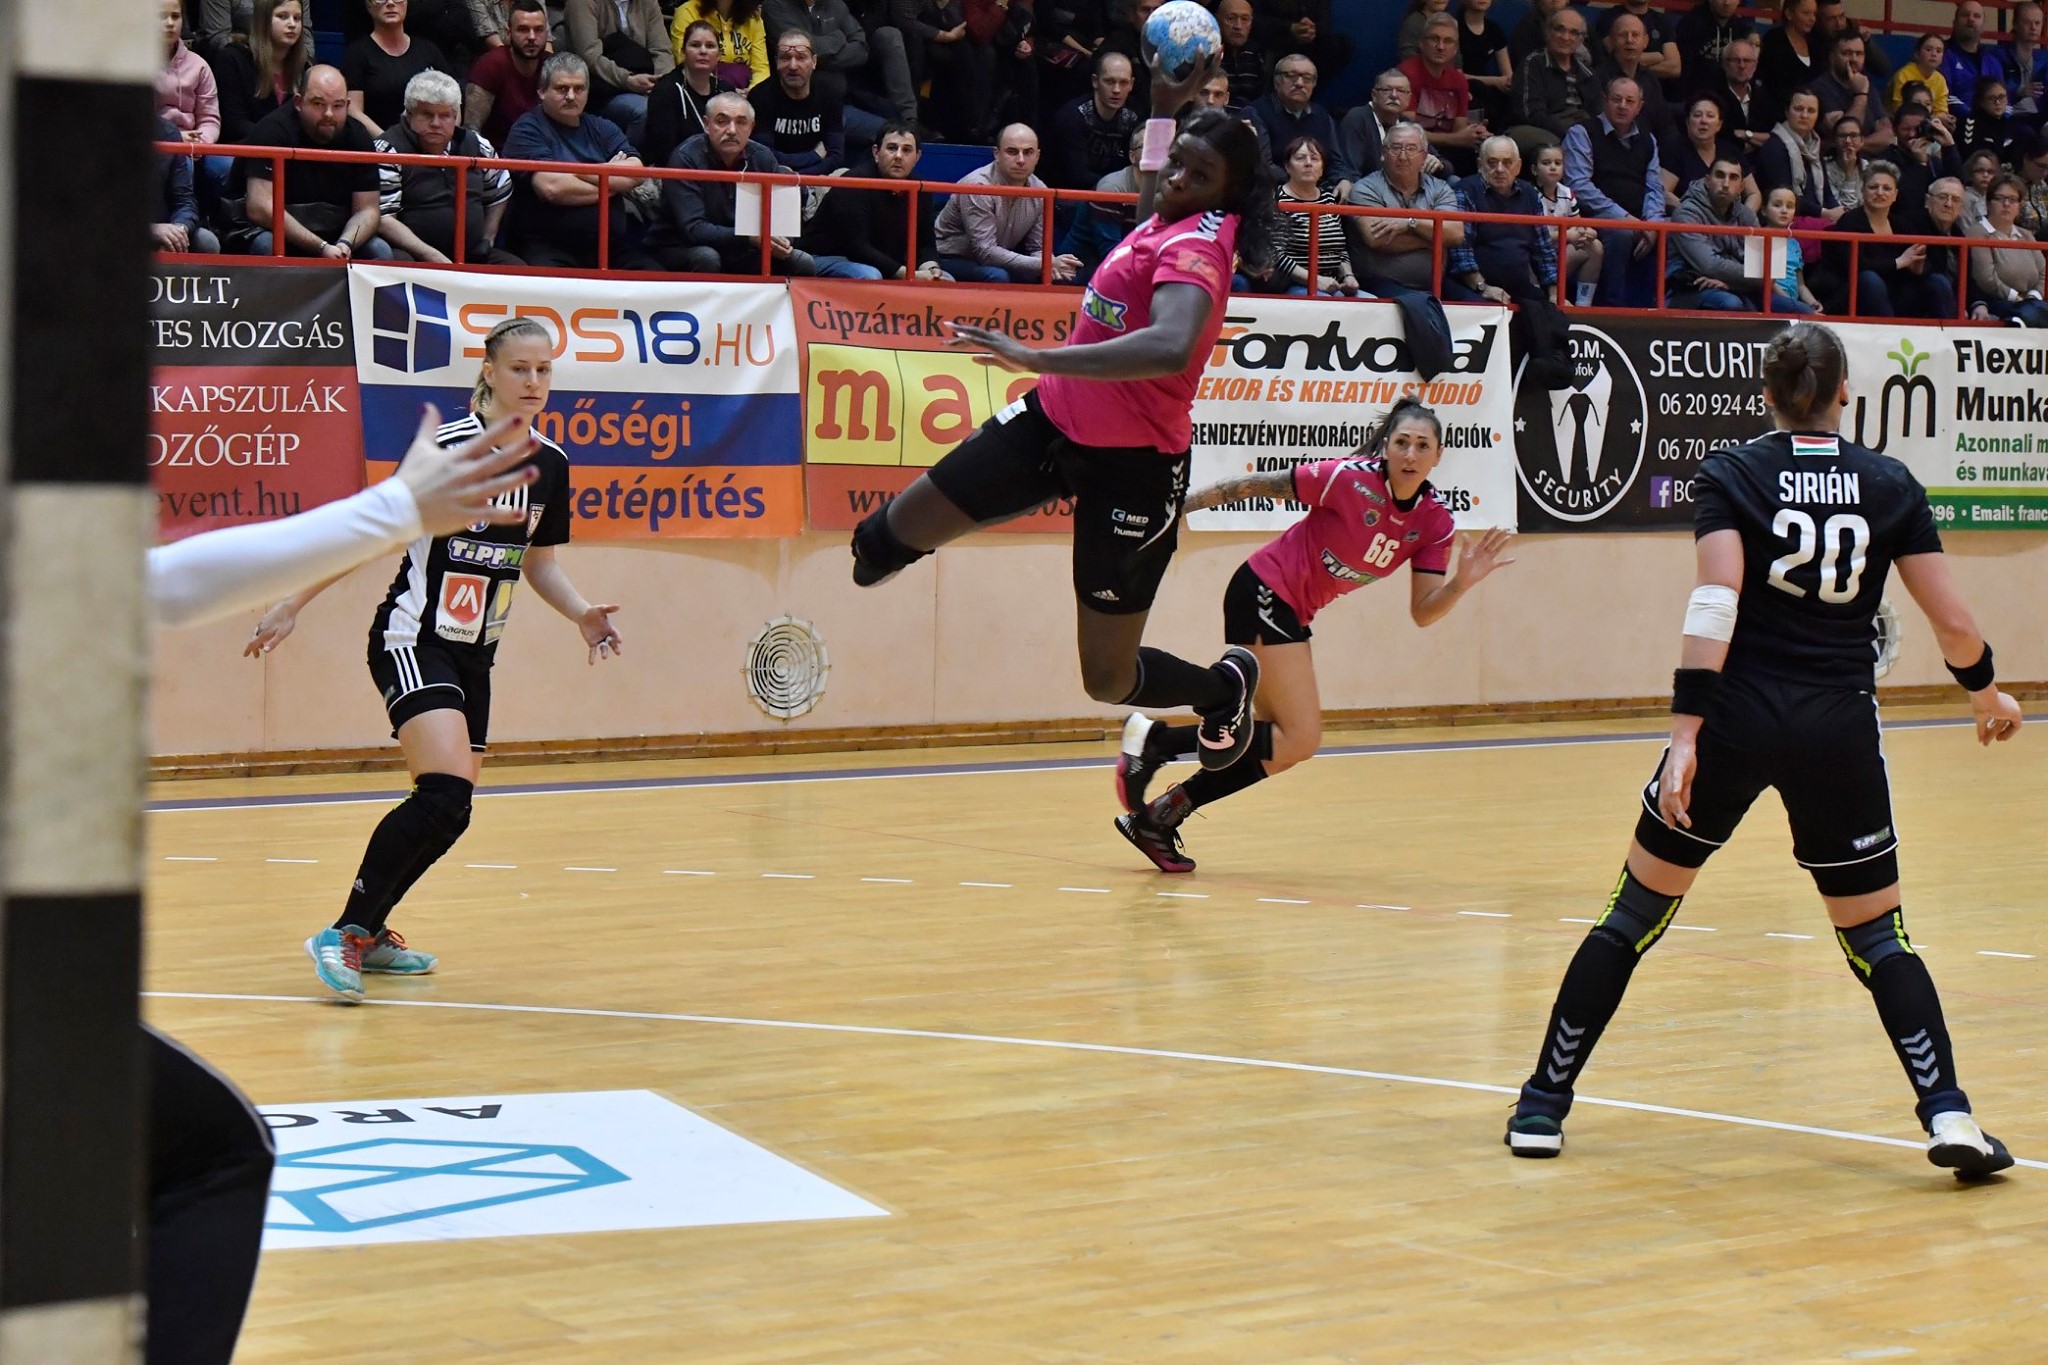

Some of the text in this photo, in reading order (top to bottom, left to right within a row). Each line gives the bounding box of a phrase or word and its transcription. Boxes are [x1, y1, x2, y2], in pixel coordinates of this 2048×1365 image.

[150, 314, 344, 349] ES MOZGÁS
[807, 300, 944, 340] Cipzárak
[1953, 339, 2048, 375] Flexu
[152, 379, 347, 413] KAPSZULÁK
[1267, 375, 1296, 402] ÉS
[1299, 377, 1398, 404] KREATÍV
[1659, 393, 1682, 416] 06
[1686, 393, 1707, 416] 20
[1711, 394, 1741, 417] 924
[1440, 423, 1493, 448] ÁCIÓK
[1658, 438, 1680, 461] 06
[1684, 438, 1705, 461] 70
[1956, 432, 2032, 453] Azonnali
[1778, 465, 1860, 504] SIRIÁN
[1956, 460, 2048, 481] és munkav
[1534, 468, 1623, 509] SECURITY
[1971, 505, 2015, 521] Email:
[1362, 532, 1400, 569] 66
[1766, 508, 1871, 604] 20
